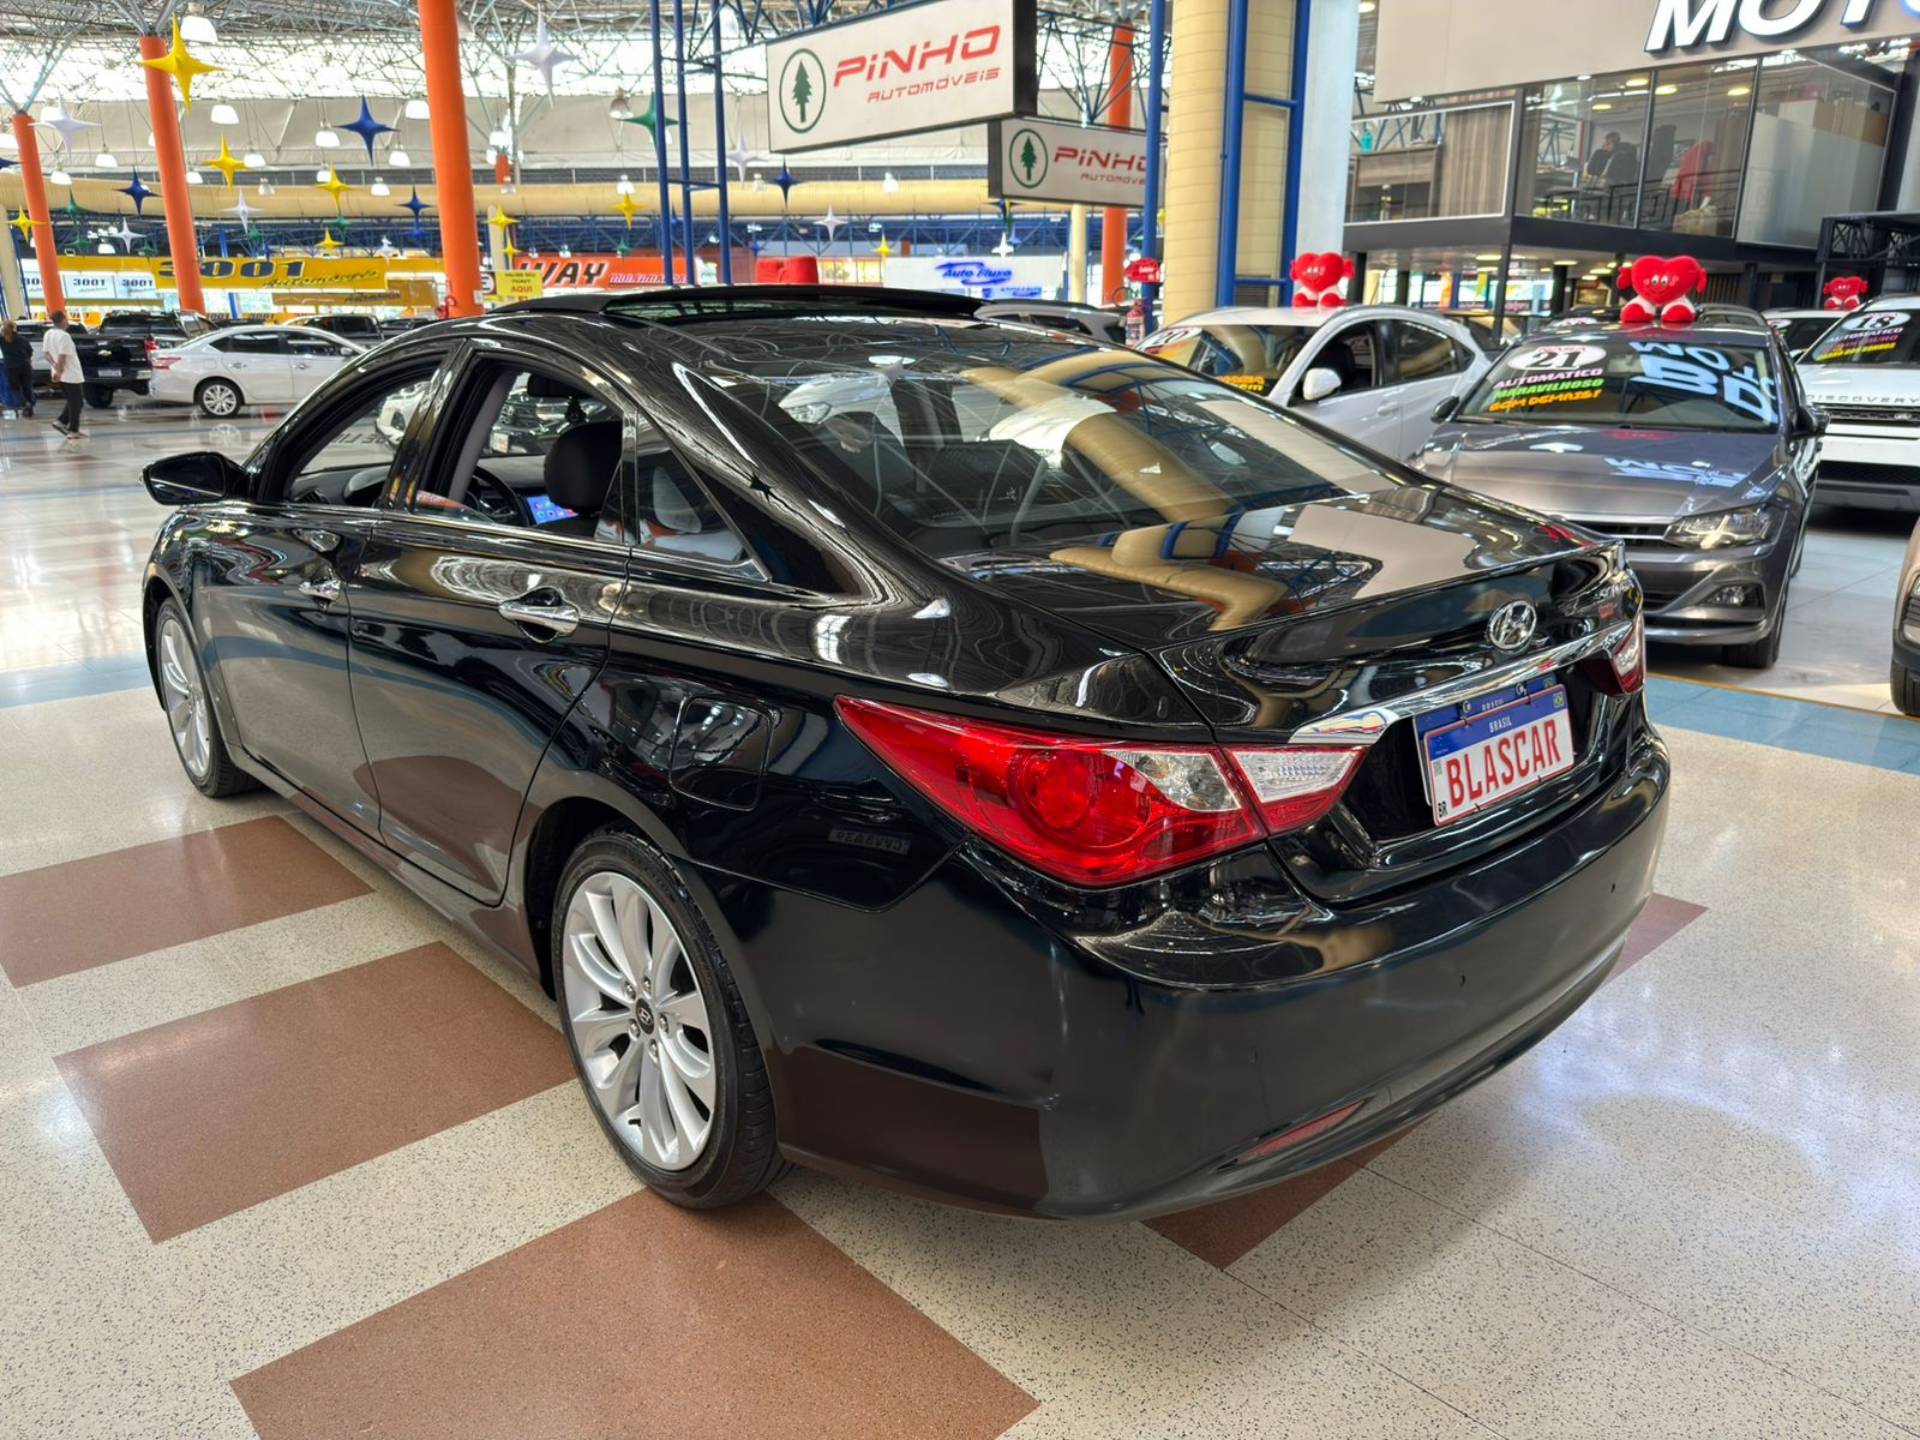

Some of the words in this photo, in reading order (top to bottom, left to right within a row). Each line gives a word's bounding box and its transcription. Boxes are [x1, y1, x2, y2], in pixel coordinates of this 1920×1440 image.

[73, 278, 105, 287] 3001
[121, 278, 153, 287] 3001
[511, 285, 533, 293] AQUI
[1526, 350, 1581, 369] 21
[1493, 368, 1604, 389] AUTOMATICO
[1493, 379, 1605, 399] MARAVILHOSO
[1806, 393, 1920, 403] DISCOVERY
[1489, 716, 1512, 733] BRASIL
[1446, 719, 1561, 808] BLASCAR
